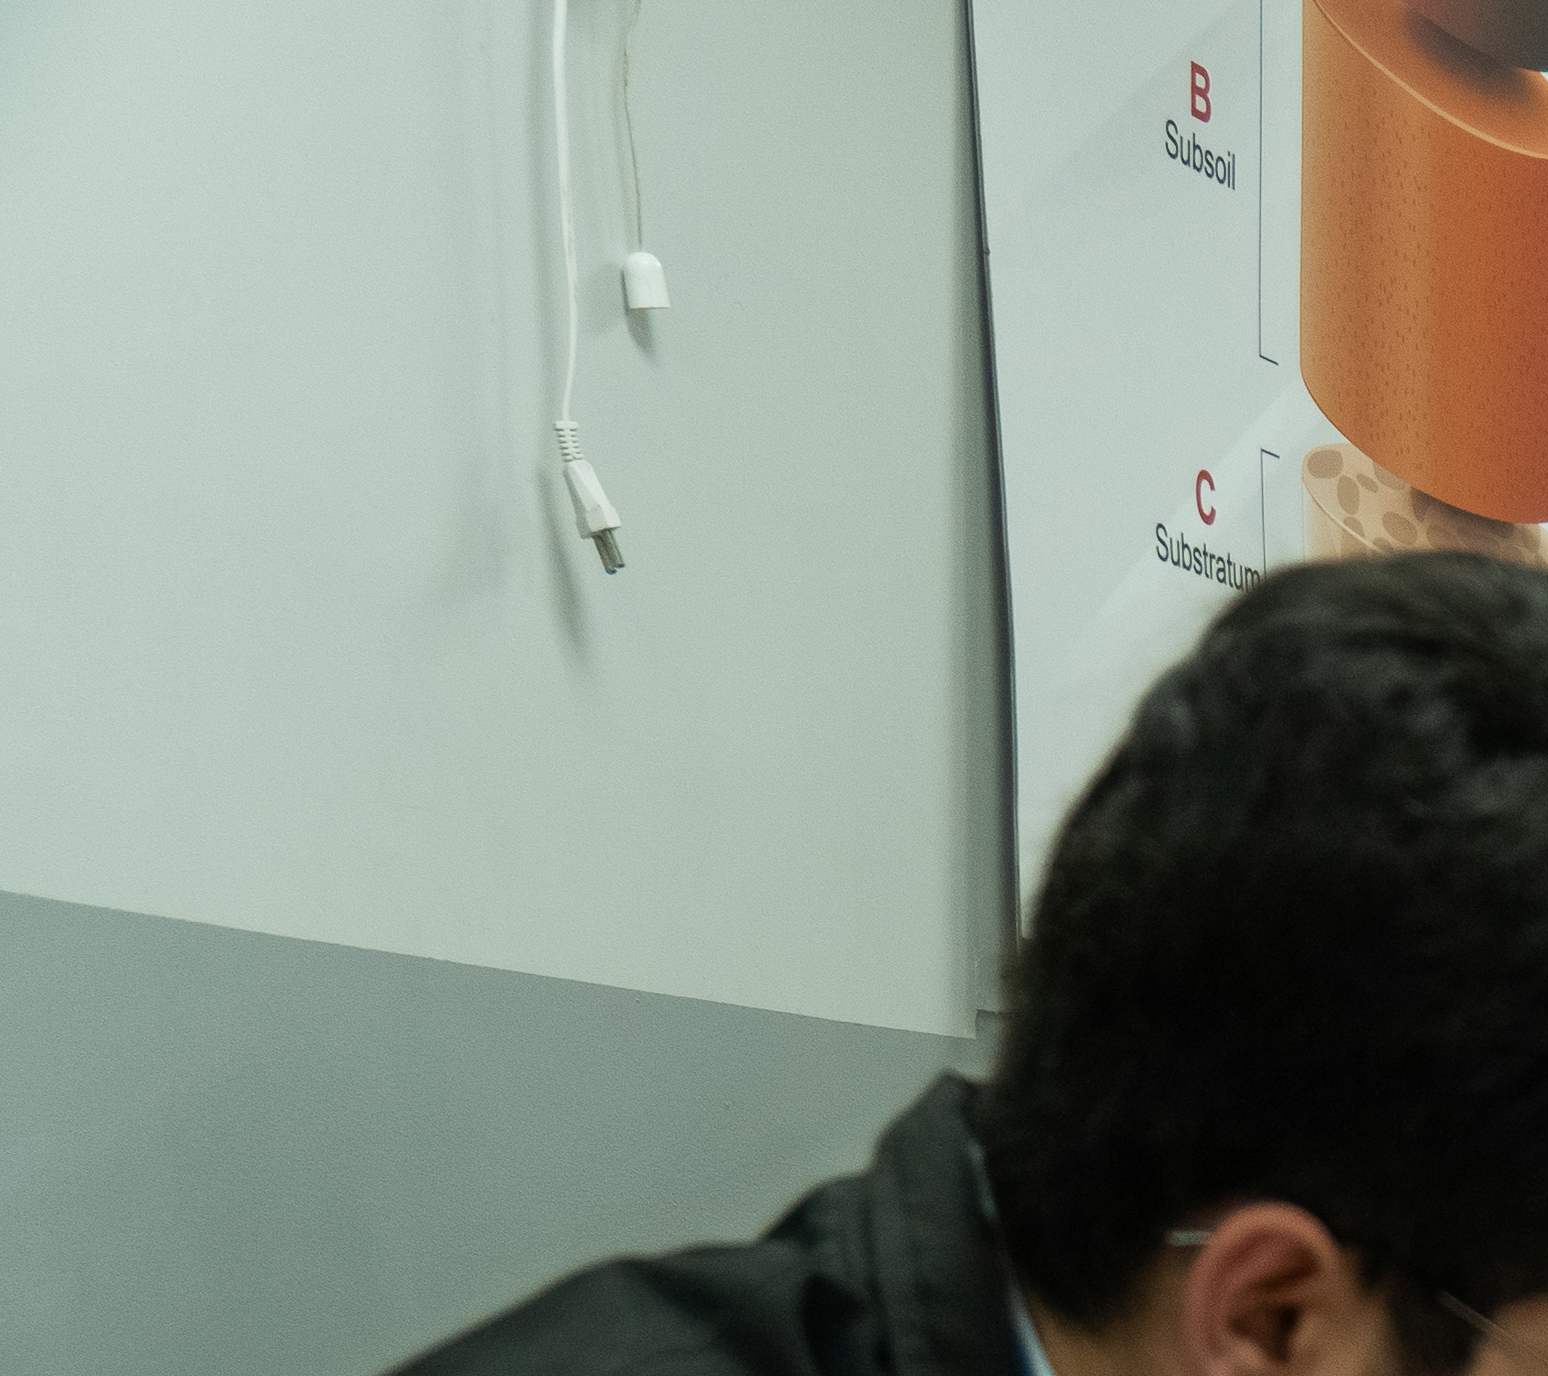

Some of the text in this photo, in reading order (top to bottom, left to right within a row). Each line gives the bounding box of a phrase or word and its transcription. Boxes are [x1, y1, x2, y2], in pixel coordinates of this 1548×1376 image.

[1190, 60, 1212, 123] B
[1165, 119, 1236, 190] Subsoil
[1196, 469, 1217, 526] C
[1155, 523, 1261, 593] Substratum
